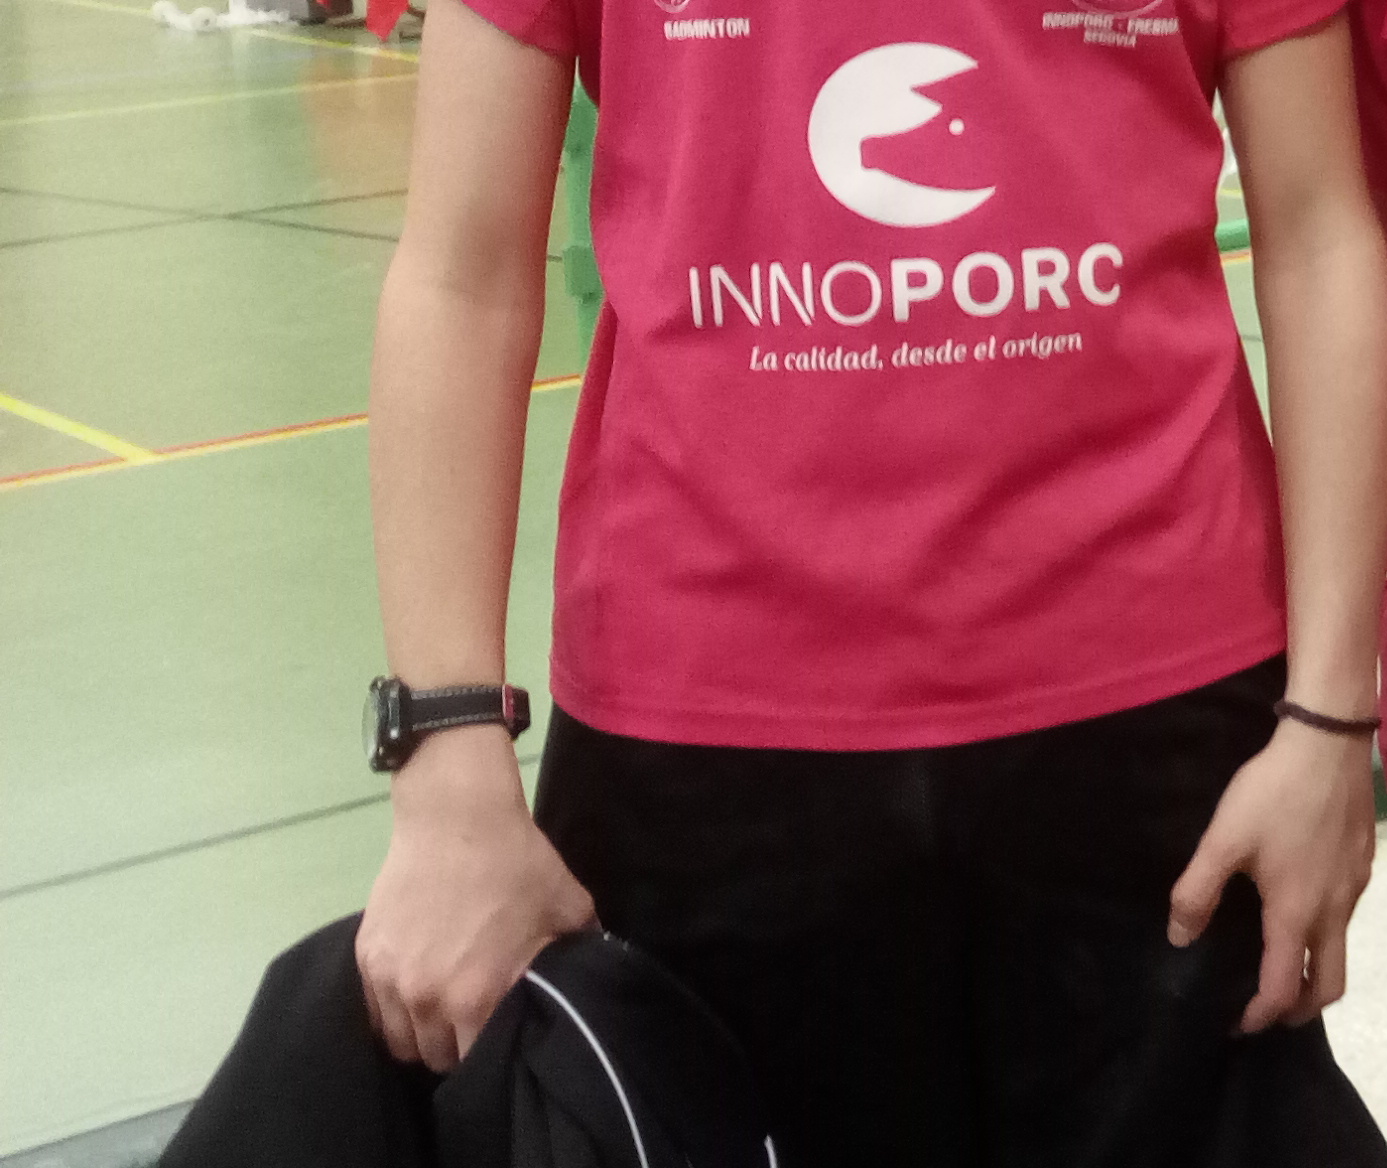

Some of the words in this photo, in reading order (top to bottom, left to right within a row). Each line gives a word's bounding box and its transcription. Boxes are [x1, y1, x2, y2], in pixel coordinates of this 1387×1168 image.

[664, 18, 750, 40] BADMINTON
[689, 242, 1124, 329] INNOPORC
[750, 346, 778, 371] La
[784, 344, 884, 371] calidad,
[892, 340, 967, 367] desde
[974, 335, 996, 361] el
[1002, 332, 1083, 359] origen
